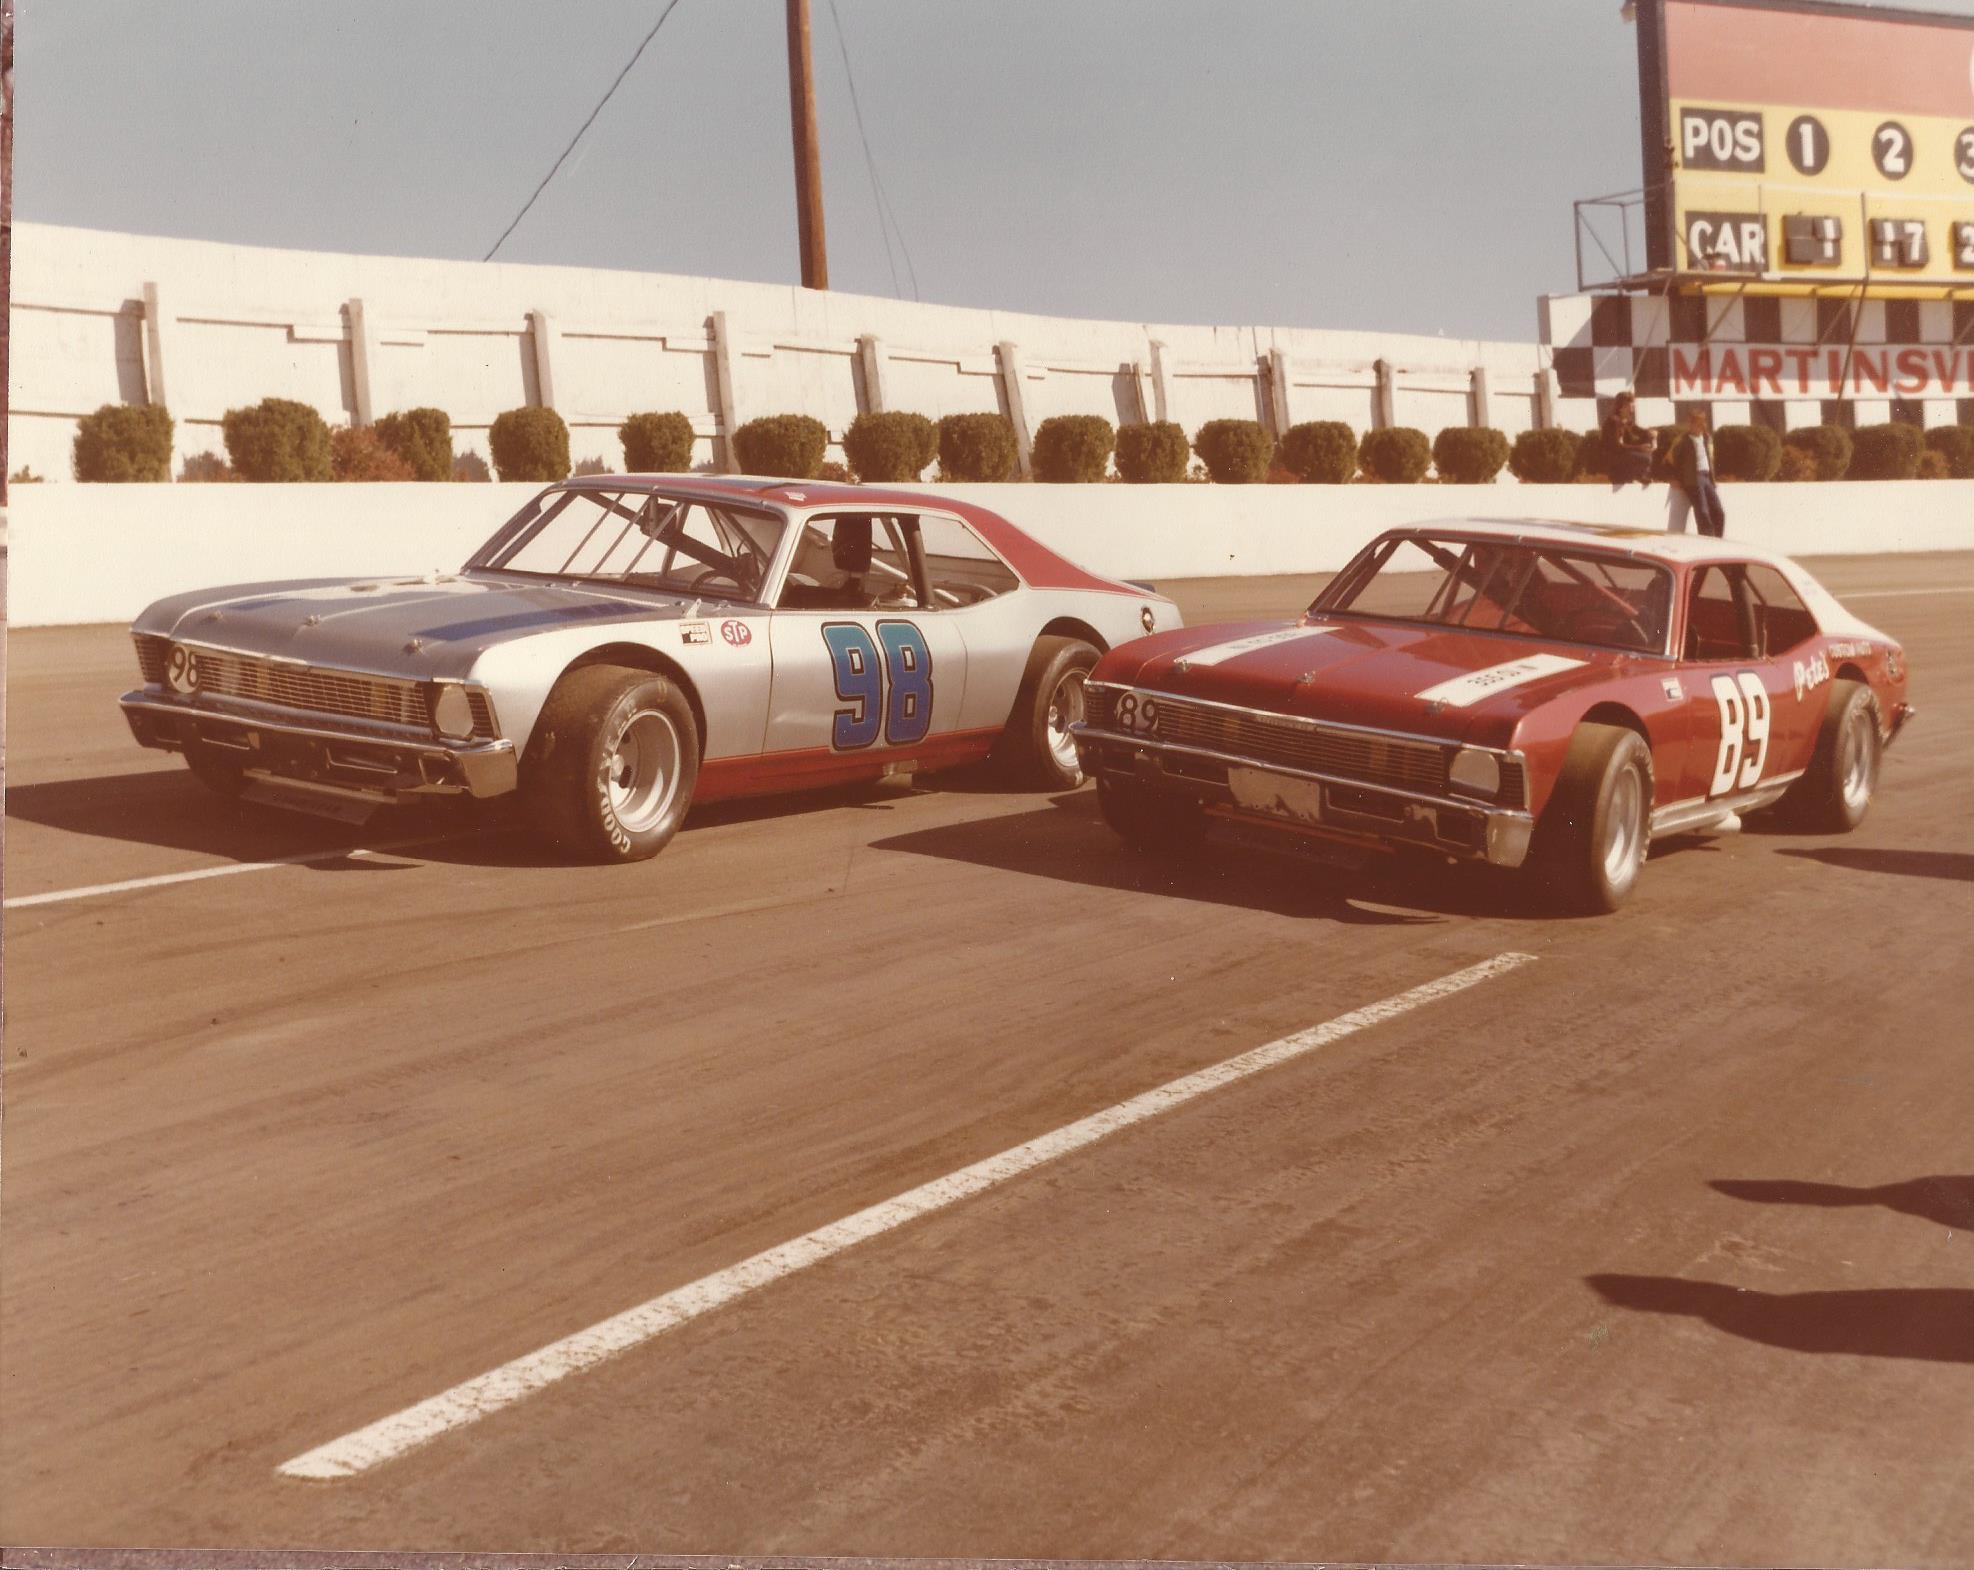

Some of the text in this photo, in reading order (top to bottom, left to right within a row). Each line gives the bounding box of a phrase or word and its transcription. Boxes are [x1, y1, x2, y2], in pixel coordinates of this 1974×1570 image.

[1683, 117, 1760, 162] POS
[1799, 123, 1815, 168] 1
[1878, 128, 1906, 173] 2
[1689, 219, 1765, 264] CAR
[1823, 218, 1835, 259] 1
[1880, 221, 1925, 261] 17
[722, 620, 749, 643] STP
[171, 645, 200, 688] 98
[821, 618, 934, 752] 98
[1119, 693, 1158, 733] 89
[1709, 670, 1771, 798] 89
